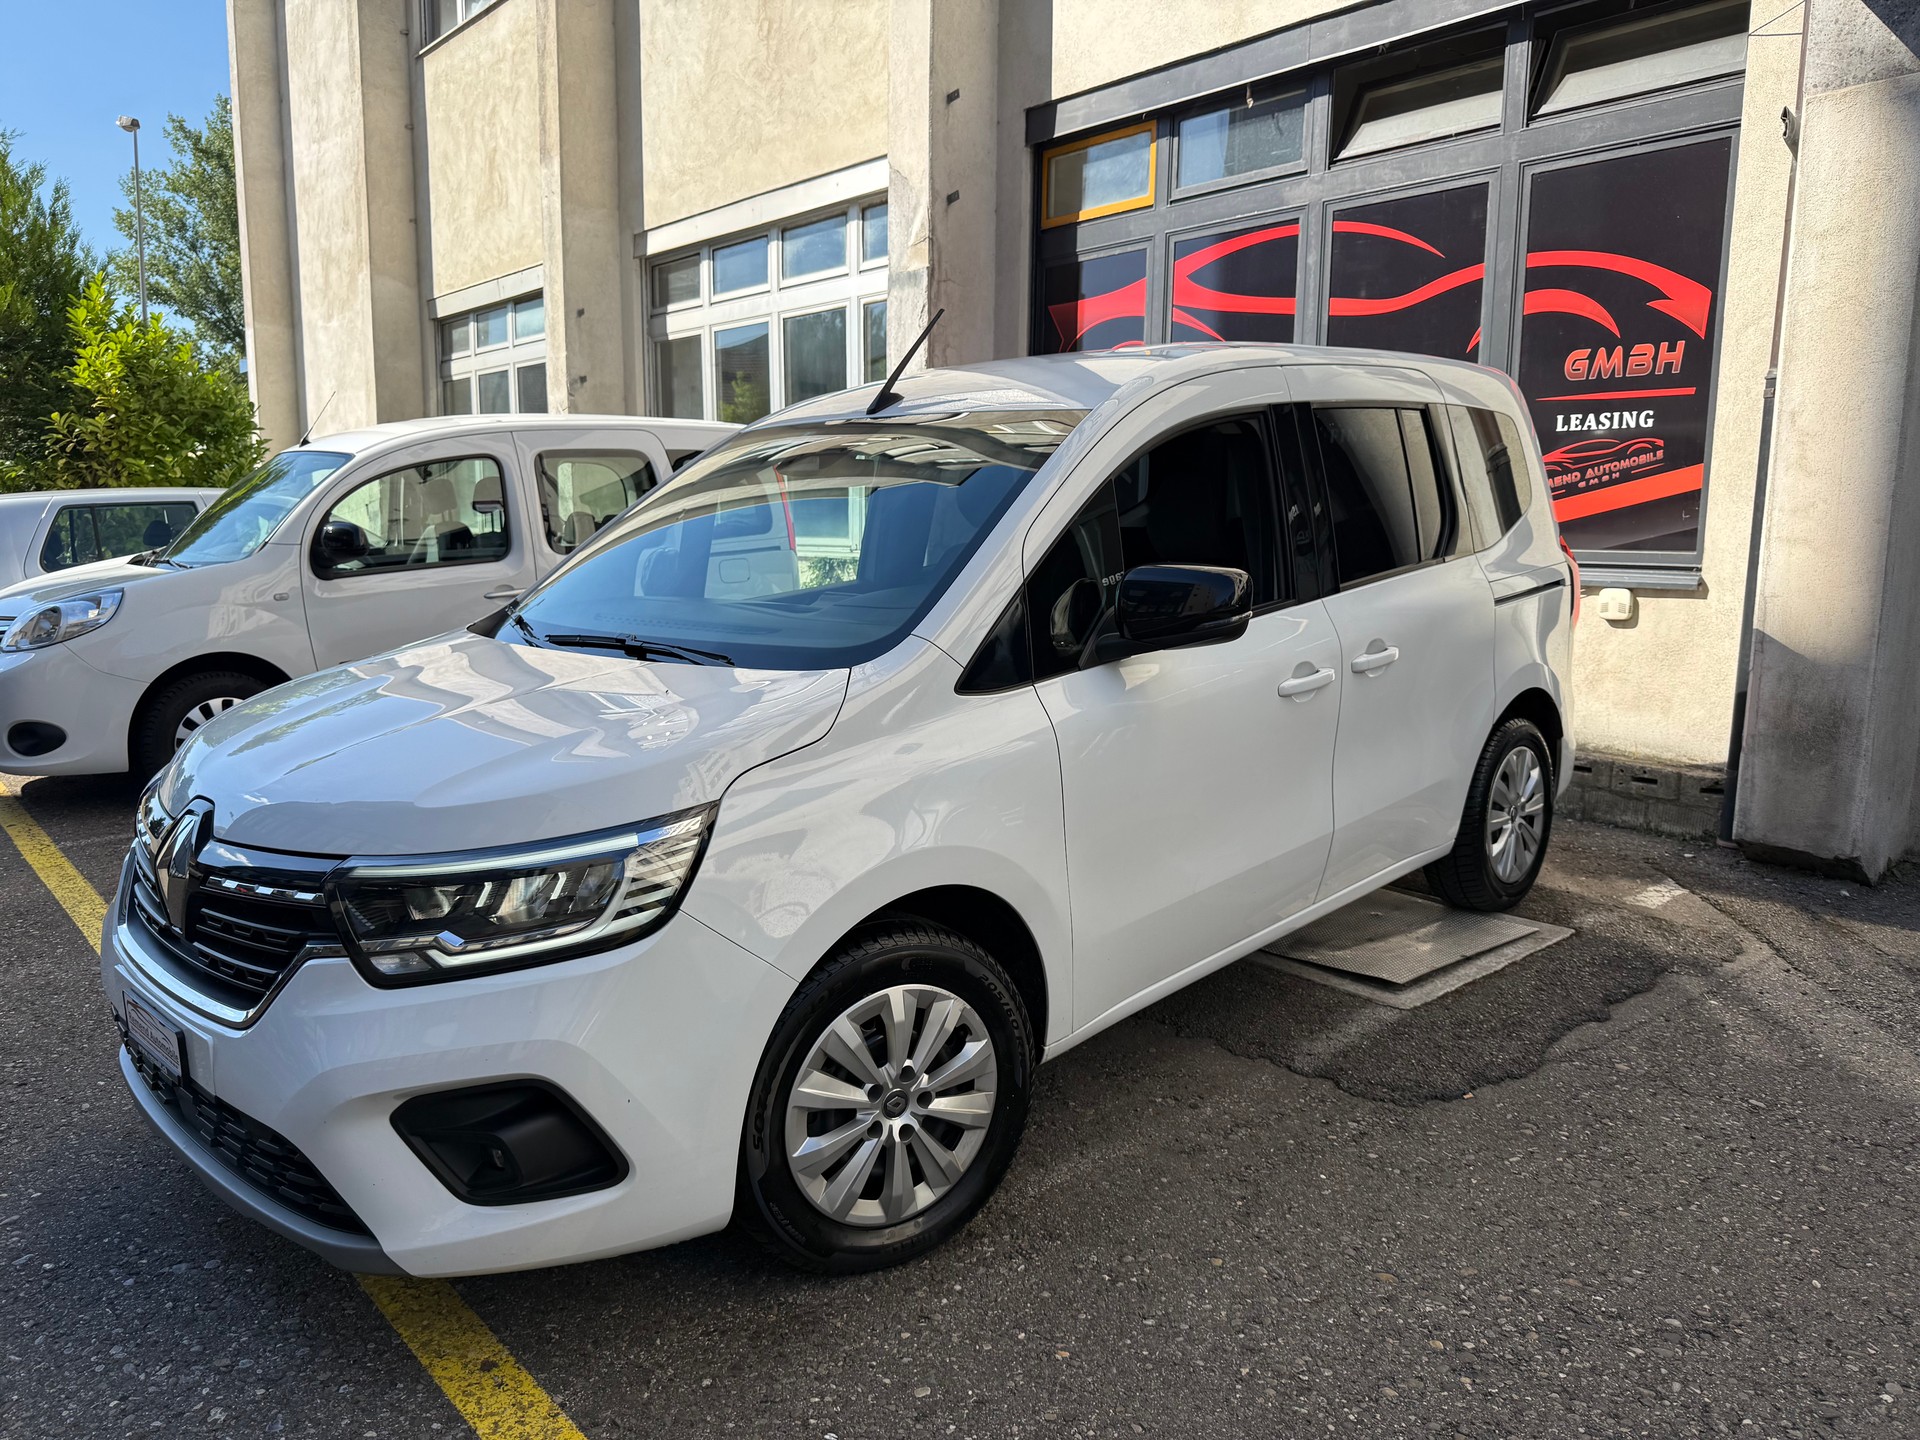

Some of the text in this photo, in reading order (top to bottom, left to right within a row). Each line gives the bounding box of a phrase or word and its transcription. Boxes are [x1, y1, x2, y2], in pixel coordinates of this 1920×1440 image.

[1564, 340, 1685, 381] GMBH
[1555, 410, 1655, 432] LEASING
[1585, 450, 1664, 479] AUTOMOBILE
